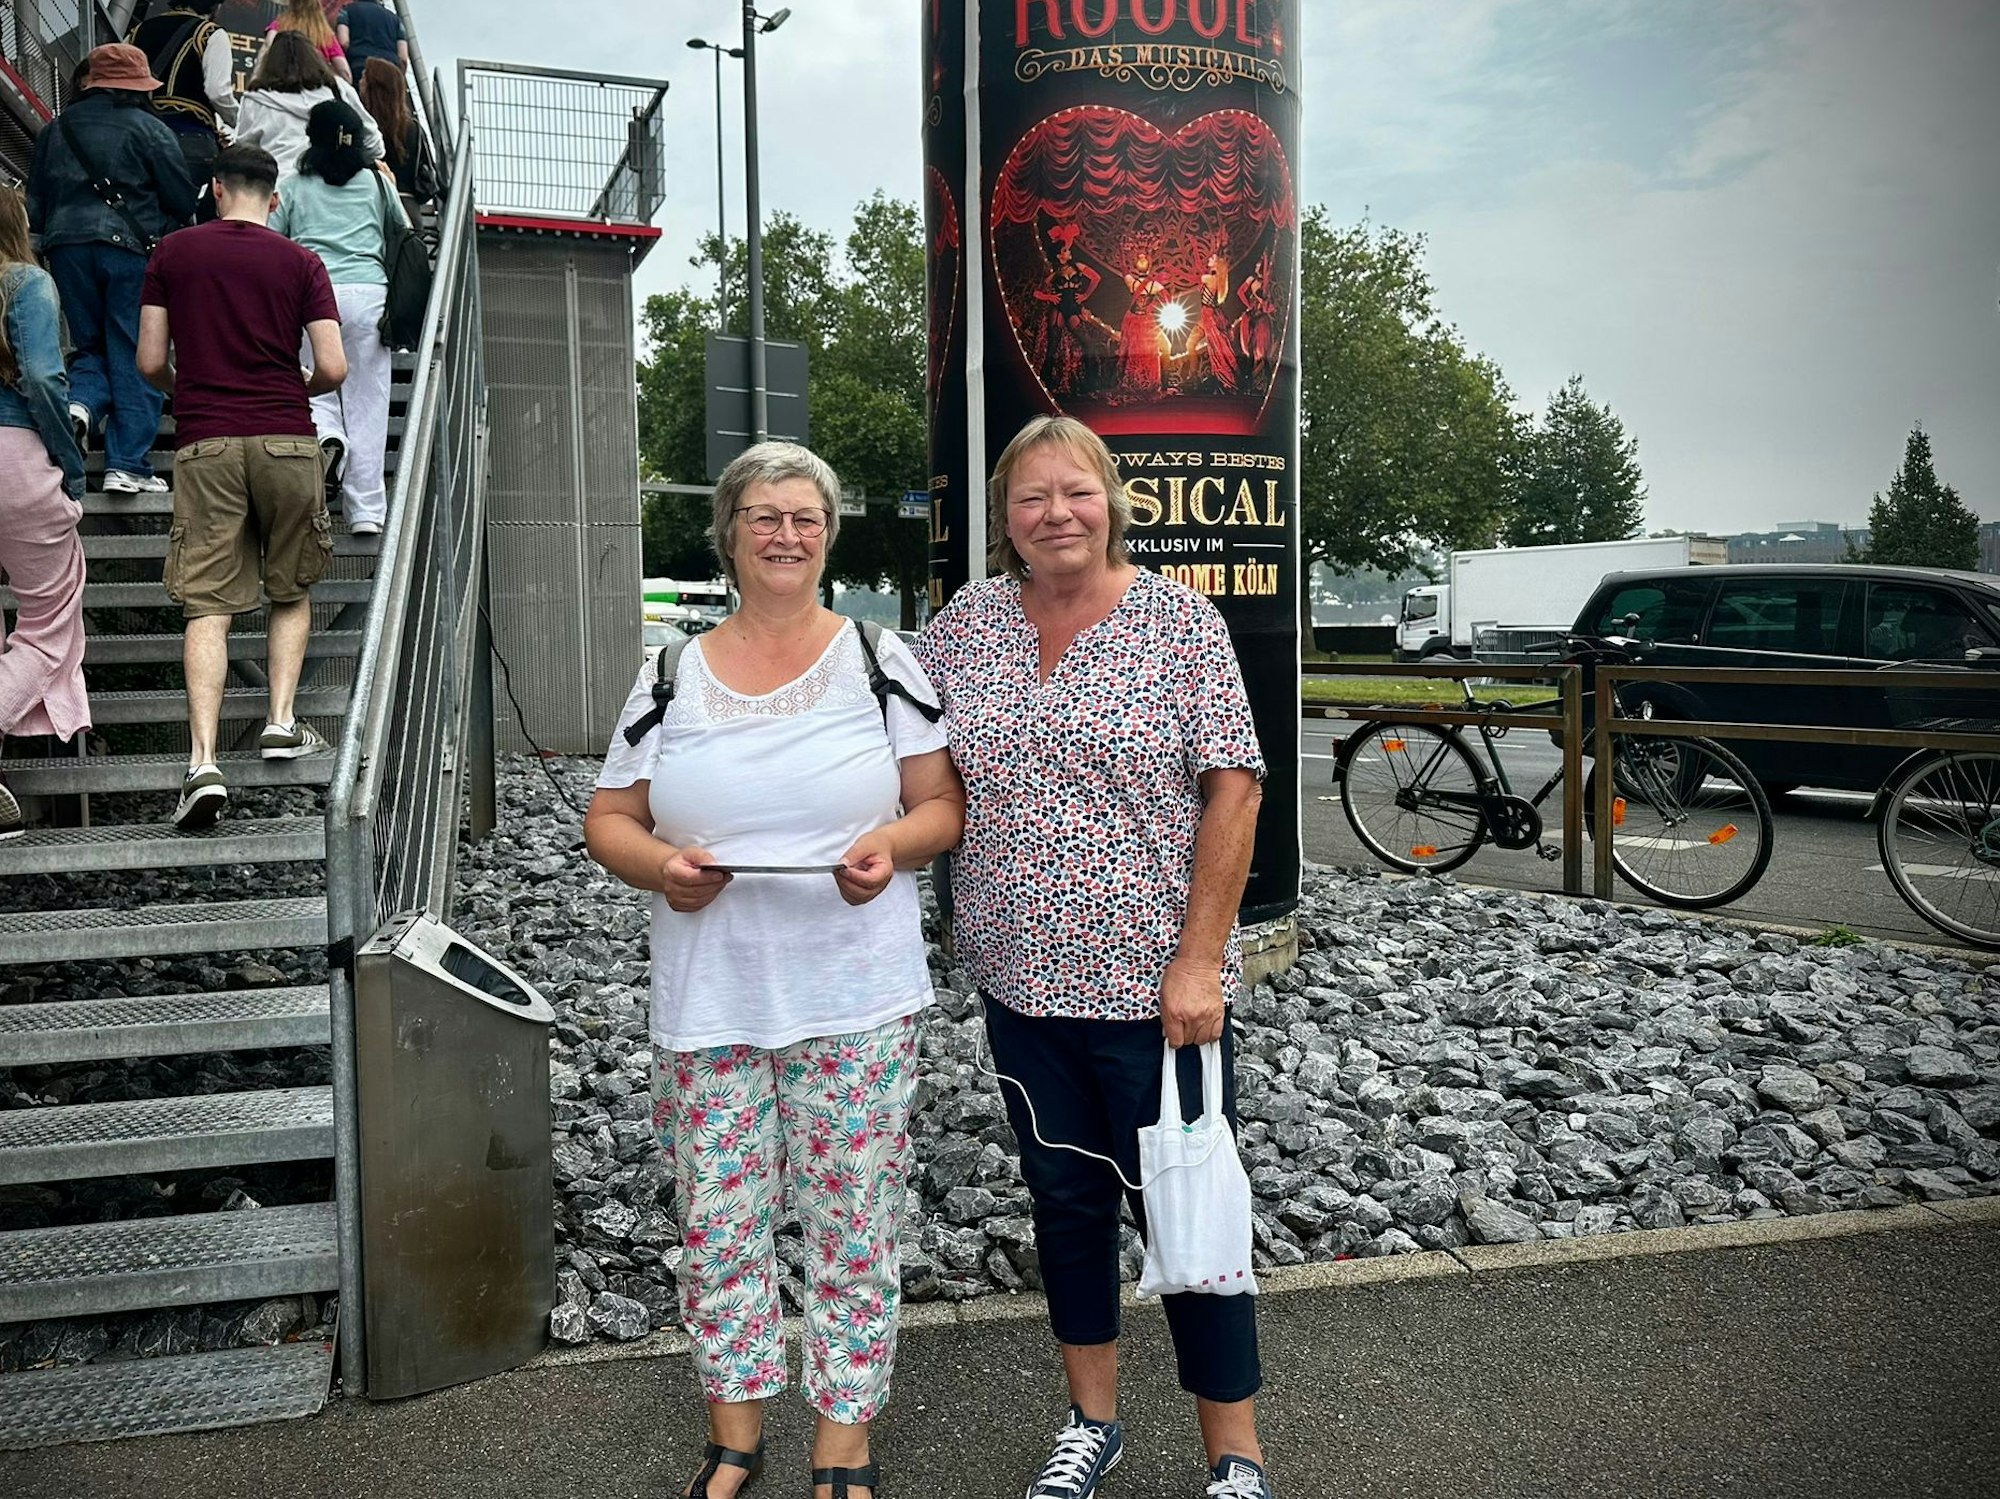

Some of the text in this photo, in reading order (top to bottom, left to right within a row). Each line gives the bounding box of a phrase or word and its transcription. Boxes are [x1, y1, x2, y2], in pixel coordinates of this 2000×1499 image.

[1070, 44, 1257, 79] DAS MUSICAL!
[1210, 452, 1286, 471] BESTES
[1122, 476, 1286, 527] SICAL
[1206, 538, 1224, 552] IM
[1233, 557, 1278, 596] KÖLN
